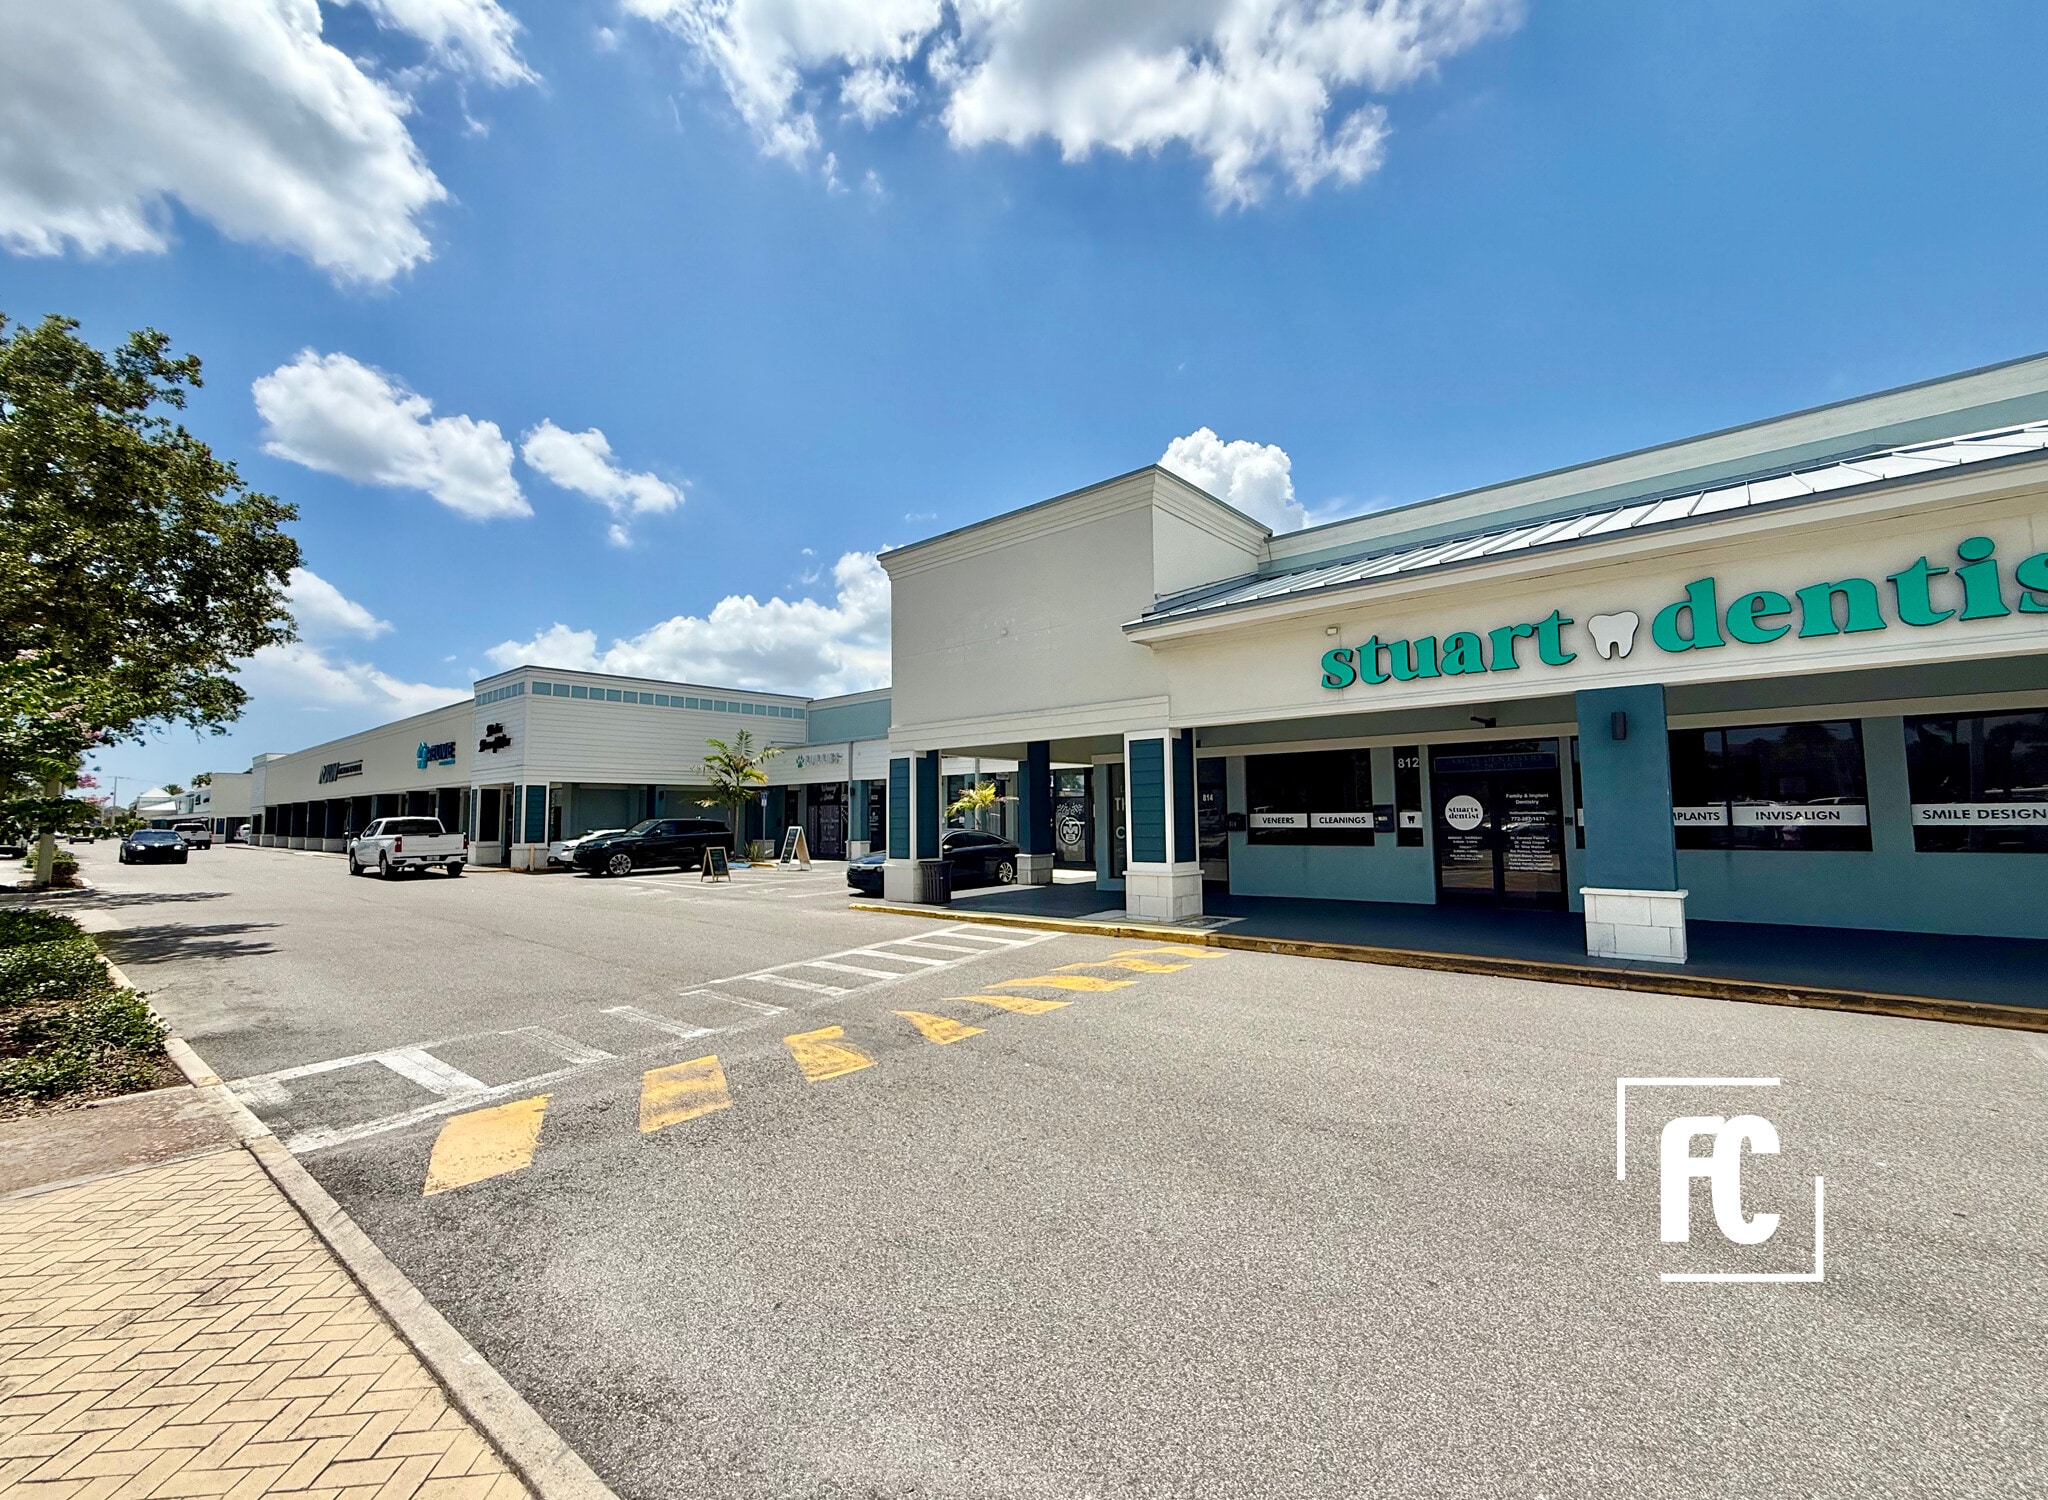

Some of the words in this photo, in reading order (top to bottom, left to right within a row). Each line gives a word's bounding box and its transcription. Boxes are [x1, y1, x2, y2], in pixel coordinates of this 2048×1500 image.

[1321, 609, 1577, 689] stuart
[1397, 757, 1420, 768] 812
[1202, 793, 1214, 802] 814
[1755, 810, 1841, 821] INVISALIGN
[1922, 808, 1971, 820] SMILE
[1977, 808, 2047, 819] DESIGN
[1262, 816, 1295, 824] VENEERS
[1319, 816, 1367, 824] CLEANINGS
